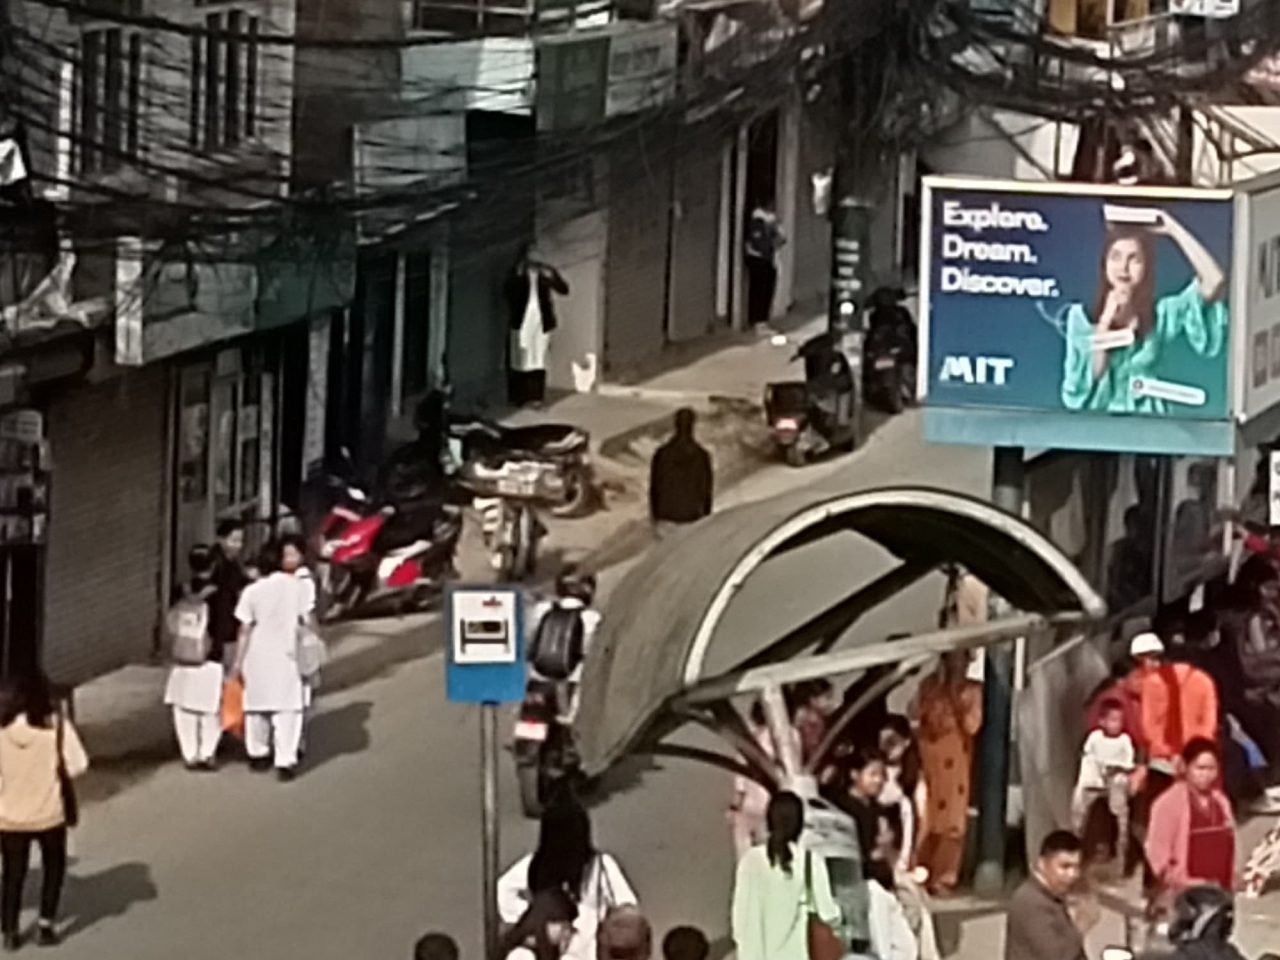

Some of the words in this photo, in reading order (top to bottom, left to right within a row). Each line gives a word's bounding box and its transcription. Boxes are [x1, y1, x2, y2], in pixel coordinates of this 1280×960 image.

[943, 201, 1049, 232] Explore.
[942, 233, 1038, 264] Dream.
[941, 266, 1061, 297] Discover.
[938, 355, 1015, 385] MIT
